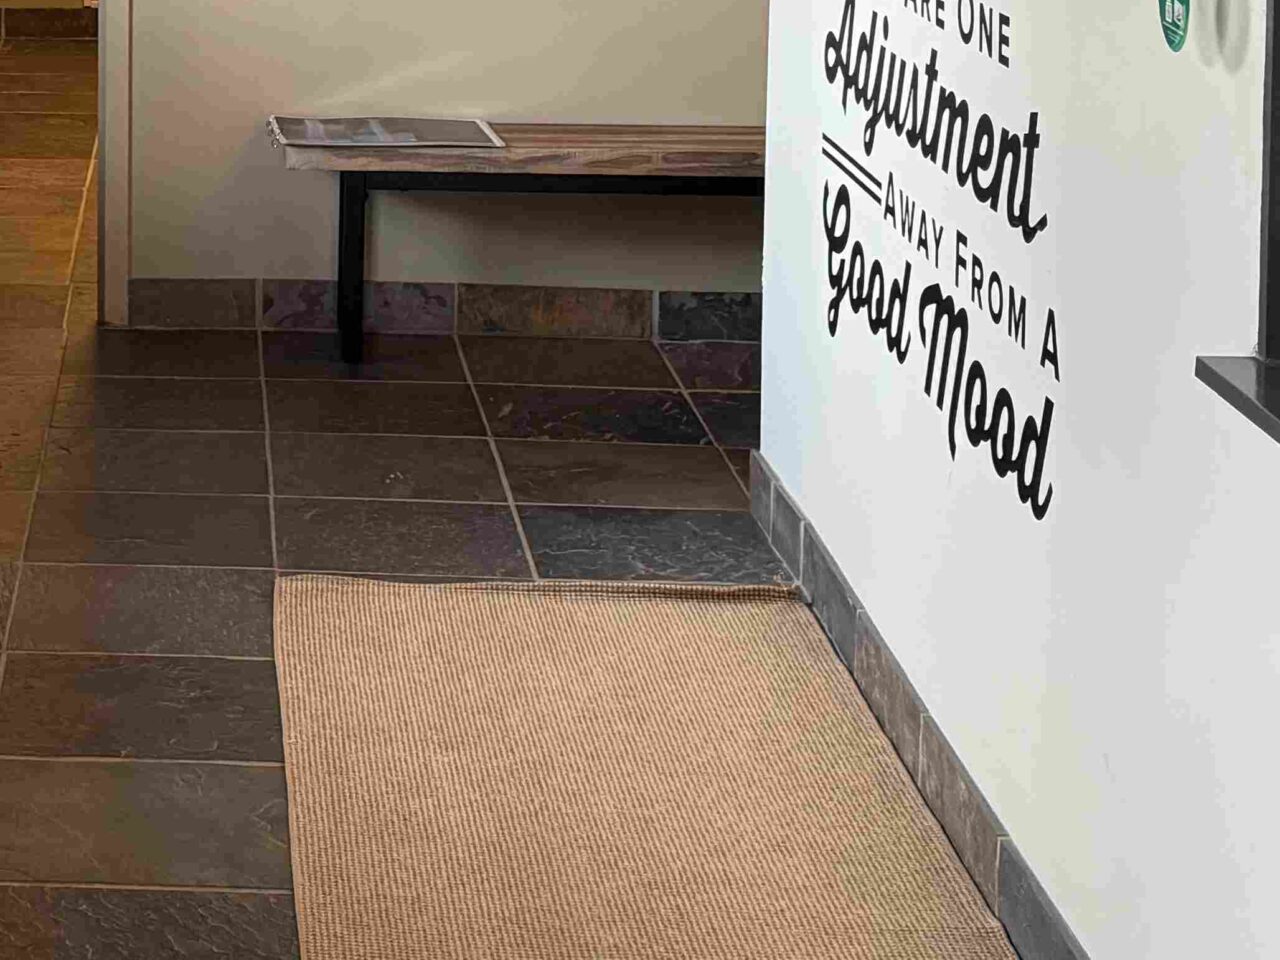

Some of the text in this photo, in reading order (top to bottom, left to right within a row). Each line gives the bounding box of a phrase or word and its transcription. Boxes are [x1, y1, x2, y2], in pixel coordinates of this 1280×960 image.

[823, 178, 1054, 521] Good Mood
[883, 171, 1061, 383] AWAY FROM A
